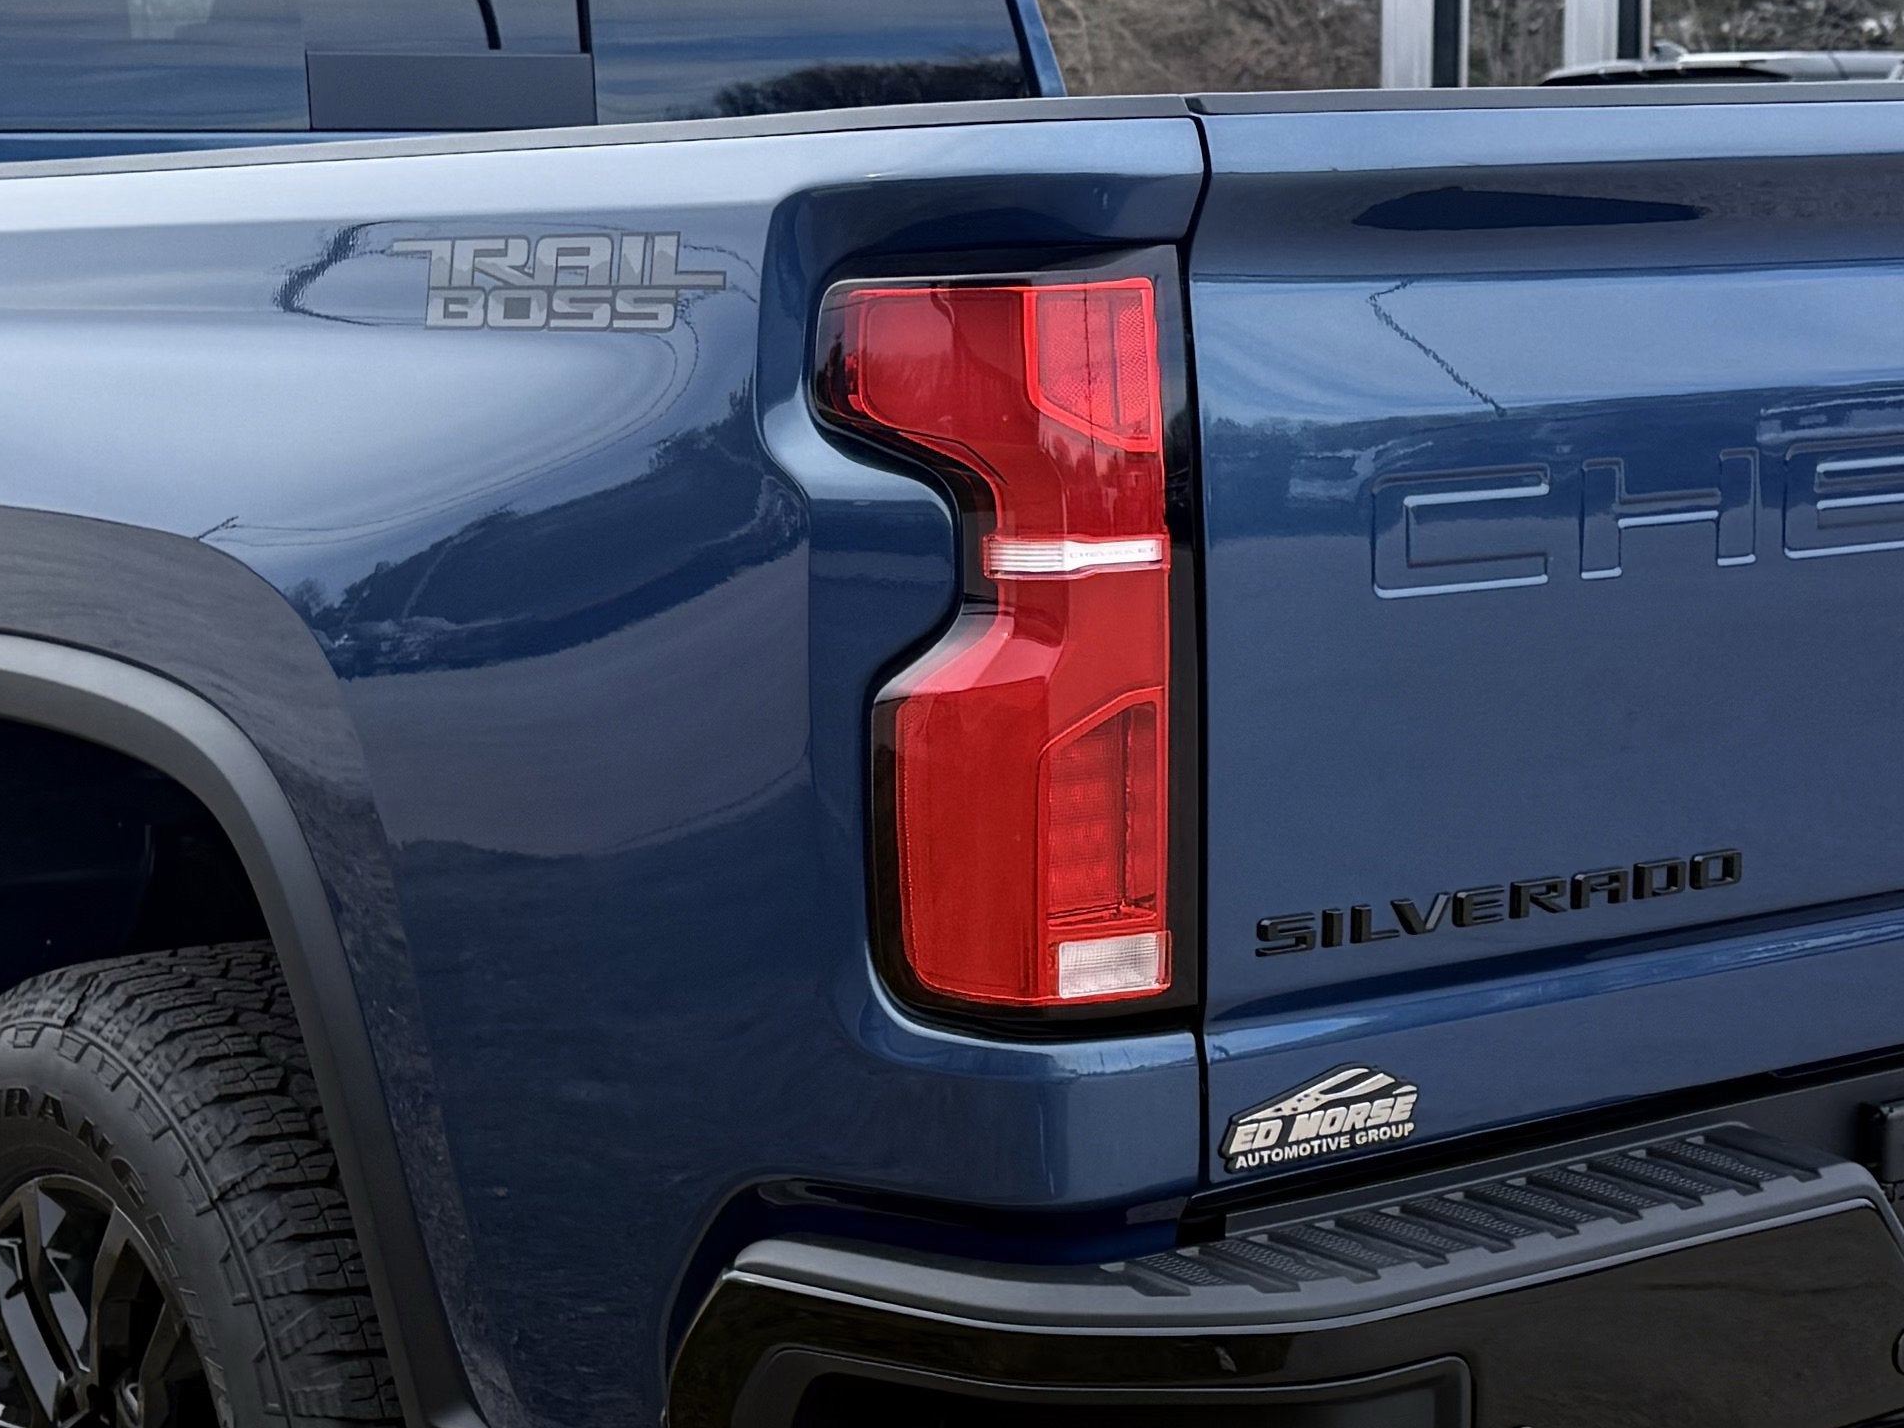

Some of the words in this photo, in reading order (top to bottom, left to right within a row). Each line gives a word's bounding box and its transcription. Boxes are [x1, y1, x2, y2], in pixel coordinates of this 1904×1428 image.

[392, 230, 727, 290] TRAIL
[425, 285, 679, 332] BOSS
[1254, 847, 1743, 957] SILVERADO
[1229, 1118, 1284, 1155] ED
[1288, 1092, 1418, 1143] MORSE
[1235, 1134, 1350, 1170] AUTOMOTIVE
[1354, 1121, 1416, 1146] GROUP
